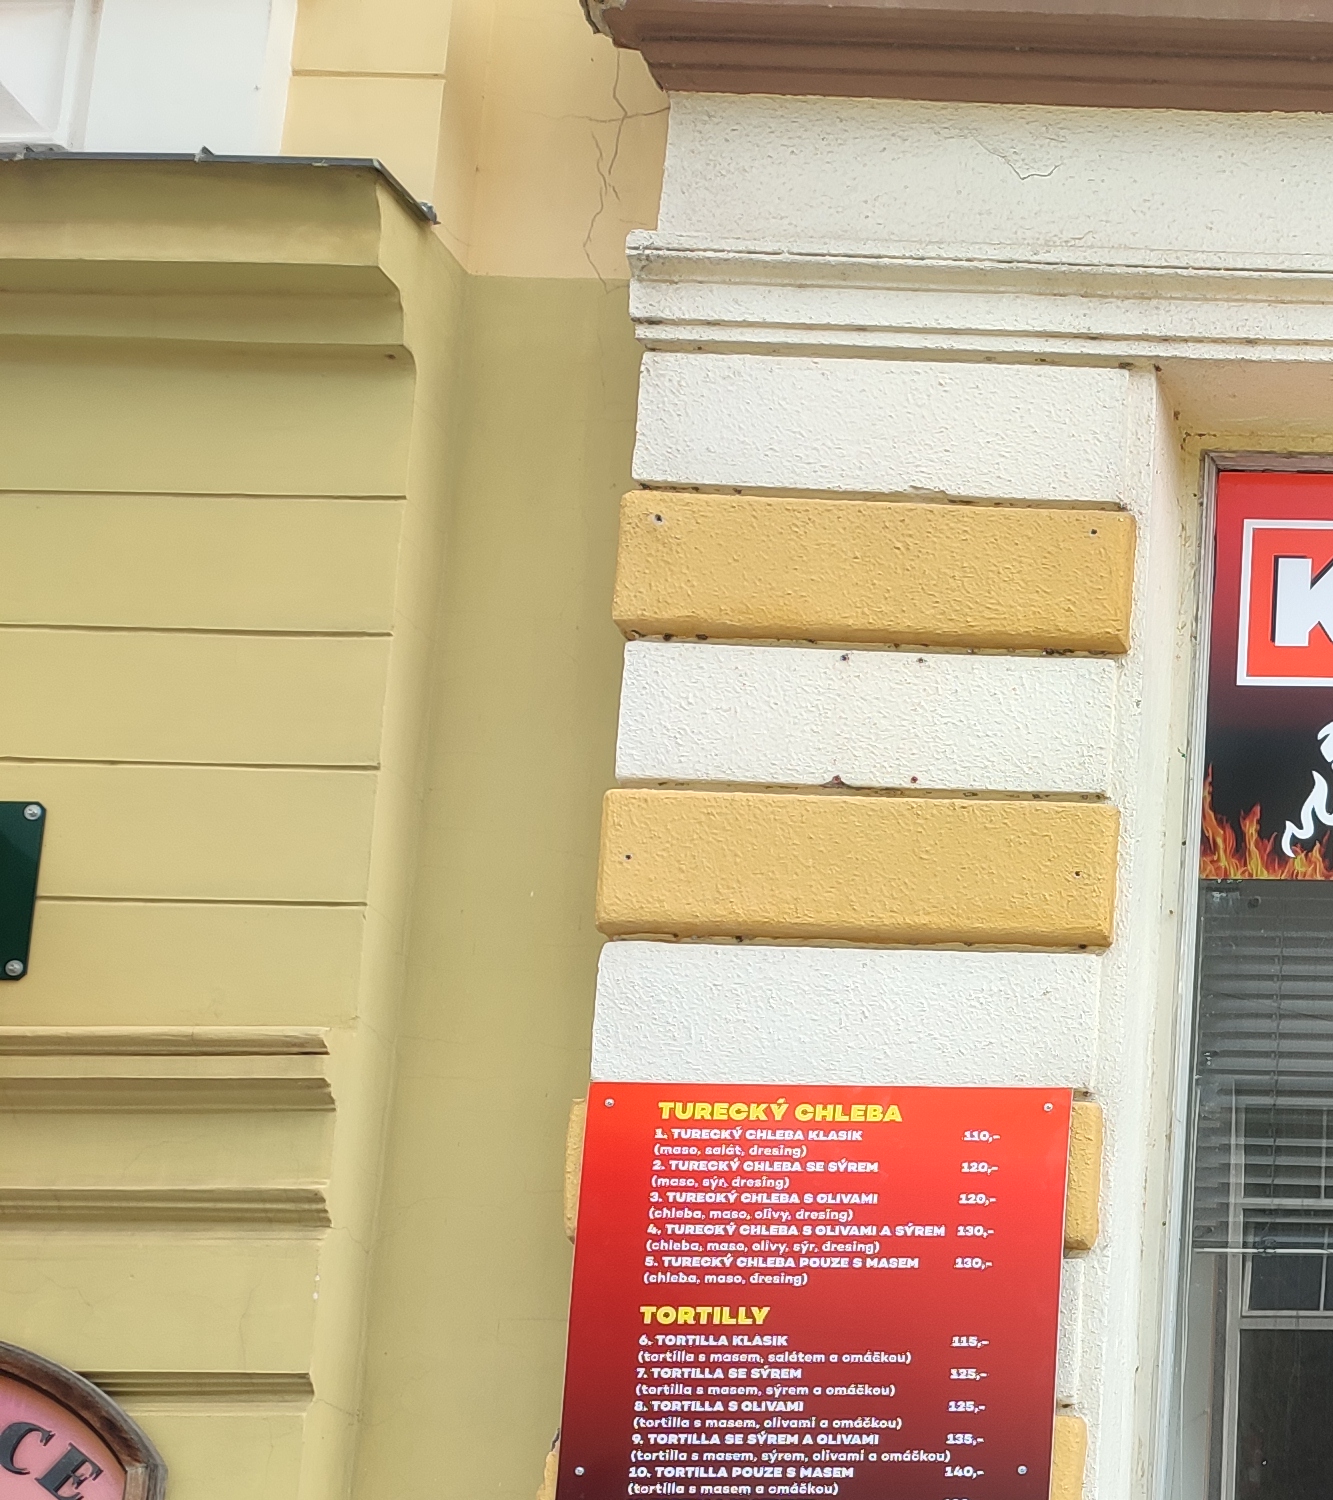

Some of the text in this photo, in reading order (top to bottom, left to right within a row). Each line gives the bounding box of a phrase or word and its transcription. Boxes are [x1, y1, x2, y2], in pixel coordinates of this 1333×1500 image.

[658, 1099, 903, 1121] TURECKÝ CHLEBA
[652, 1160, 666, 1169] 2.
[668, 1158, 741, 1171] TURECKÝ
[742, 1161, 804, 1171] CHLEBA
[805, 1162, 825, 1171] SE
[827, 1160, 879, 1172] SÝREM
[639, 1306, 771, 1324] TORTILLY
